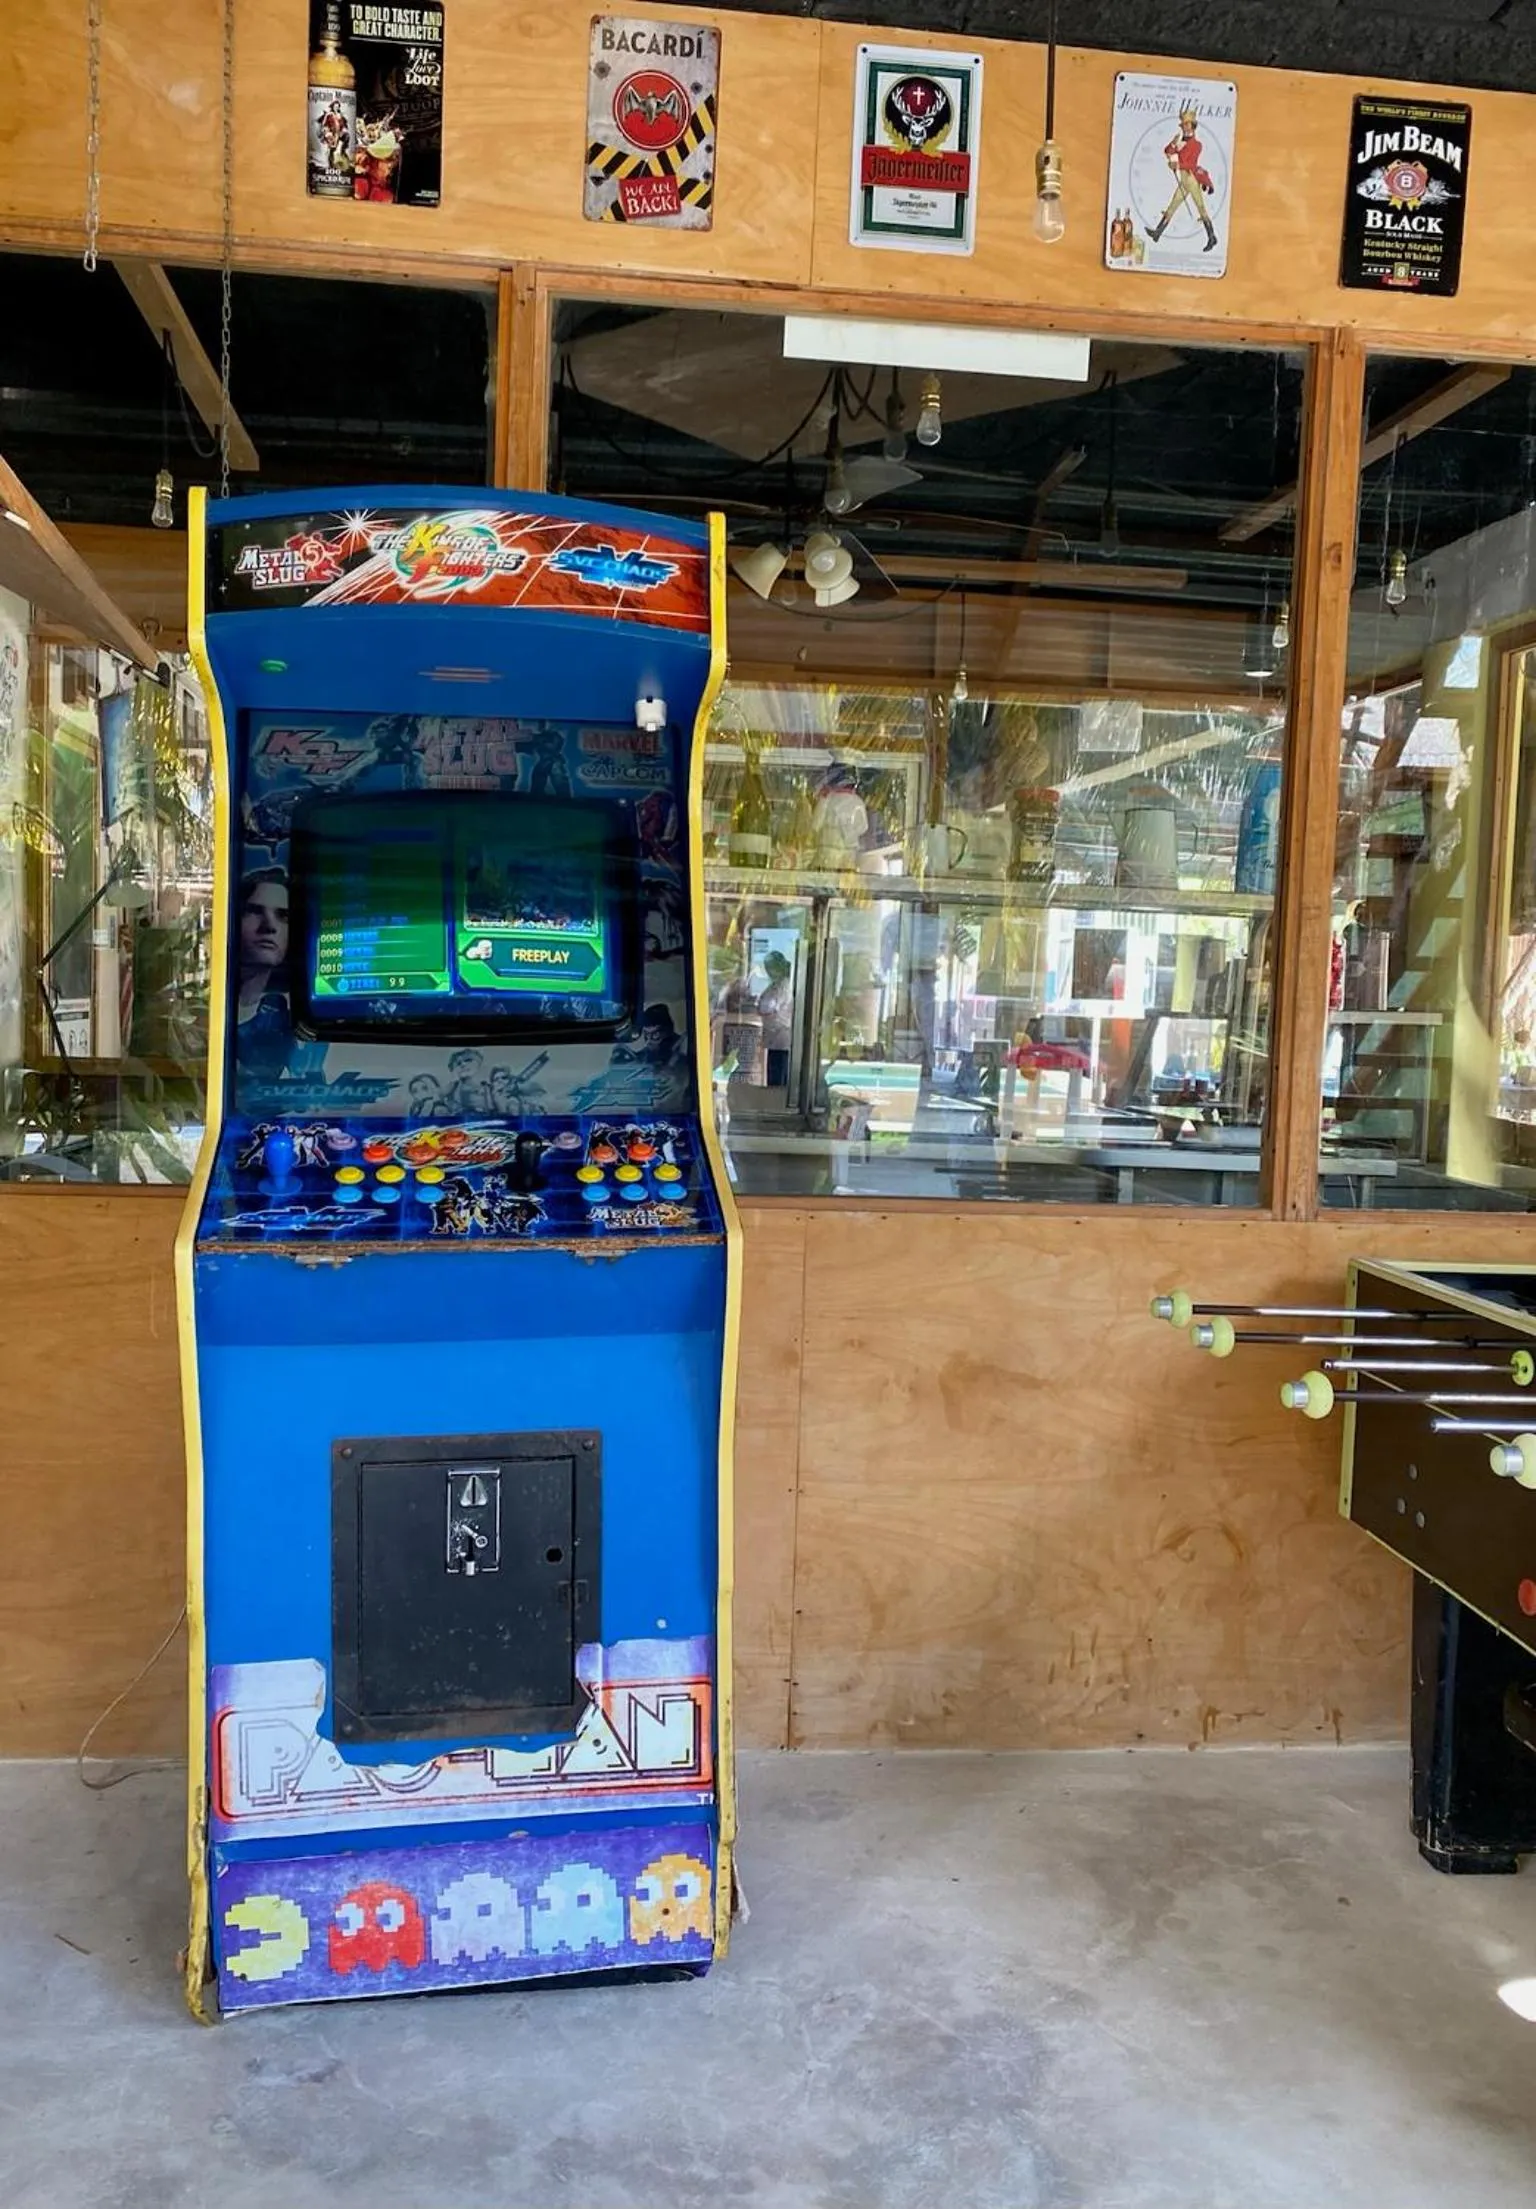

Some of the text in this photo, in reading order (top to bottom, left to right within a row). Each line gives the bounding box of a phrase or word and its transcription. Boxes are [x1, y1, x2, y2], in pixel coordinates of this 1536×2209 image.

[350, 4, 363, 20] TO
[364, 6, 390, 21] BOLD
[392, 8, 421, 24] TASTE
[422, 11, 443, 26] AND
[353, 20, 443, 42] GREAT CHARACTER.
[601, 28, 705, 59] BACARDÍ
[405, 47, 437, 64] Life
[405, 75, 440, 86] LOOT
[1118, 93, 1176, 113] JOHNNIE
[1357, 125, 1463, 173] JIM BEAM
[625, 182, 672, 197] WE ARE
[627, 195, 678, 215] BACK!
[1364, 209, 1444, 234] BLACK
[1364, 239, 1443, 253] Kentucky Straight
[373, 533, 411, 550] THE
[238, 549, 304, 570] METAL
[255, 565, 305, 586] SLUG
[423, 742, 518, 776] SLUG
[512, 948, 570, 964] FREEPLAY
[696, 1793, 714, 1806] T
